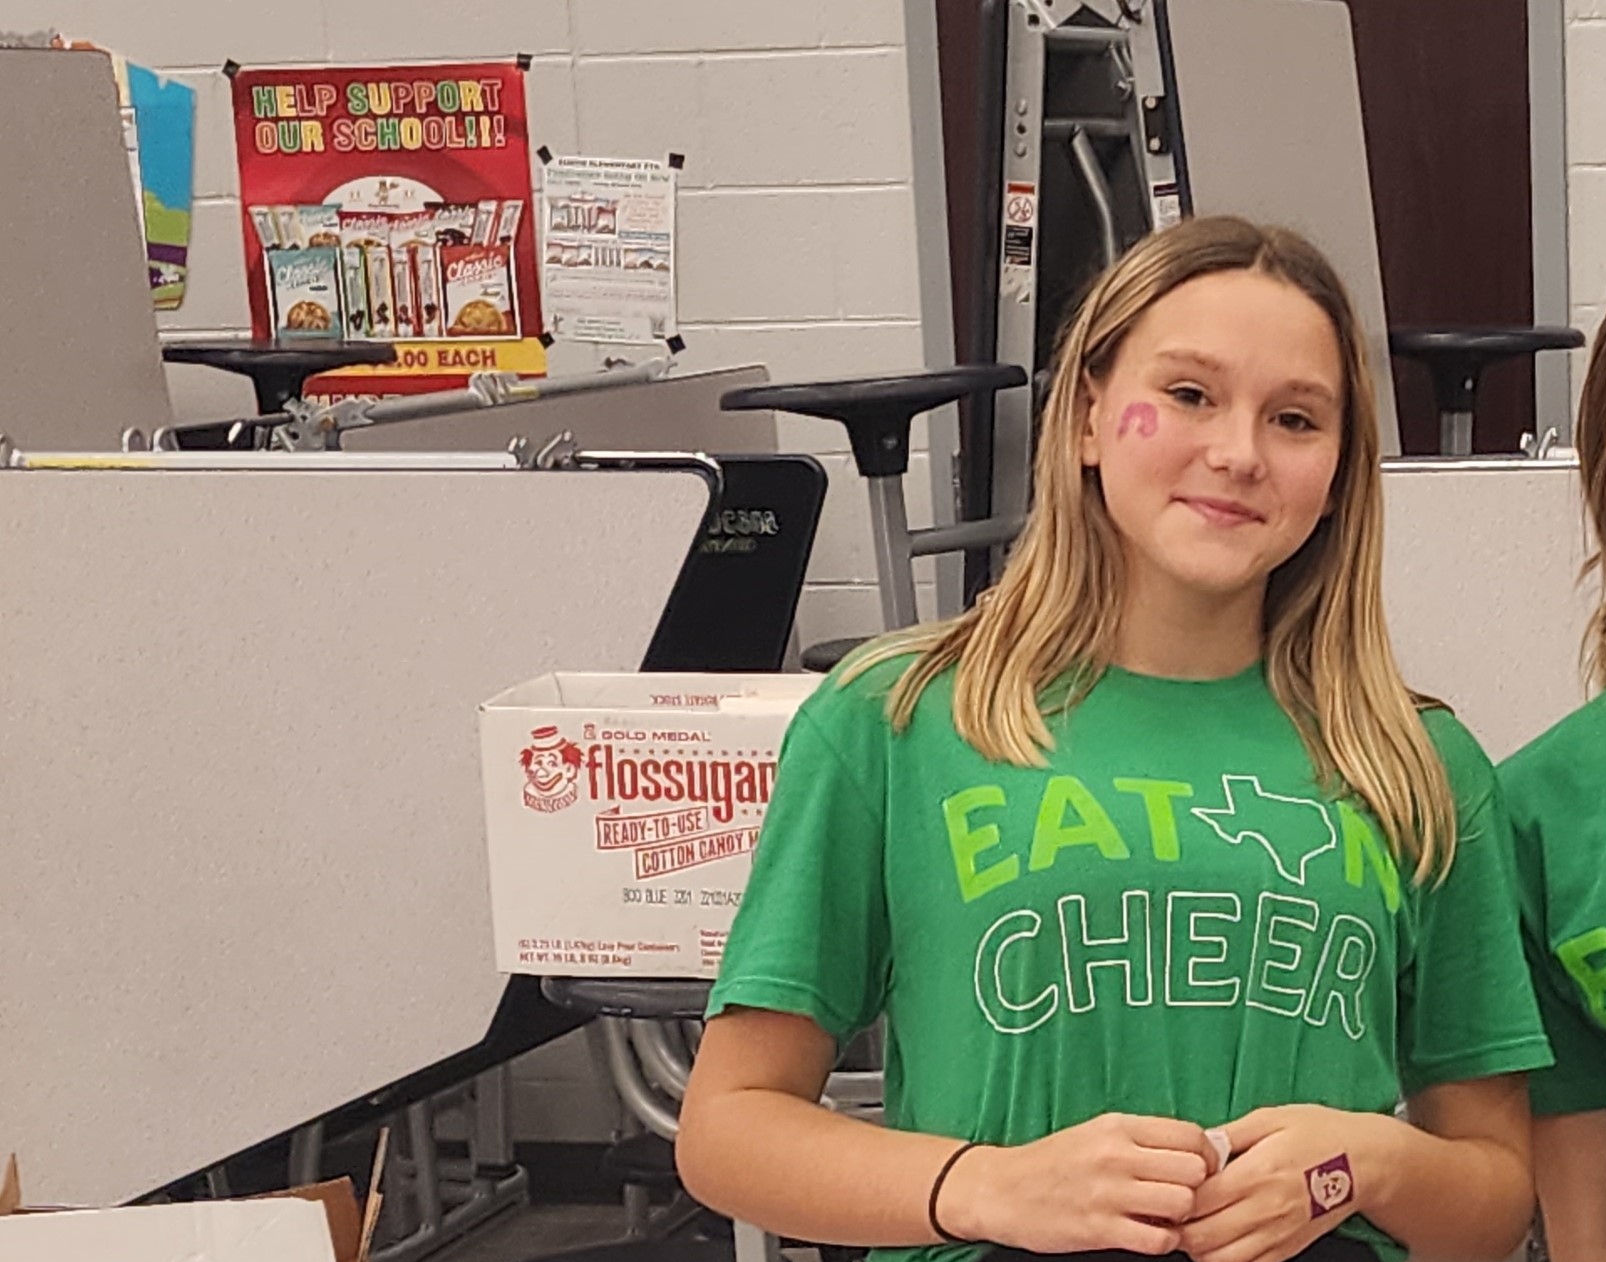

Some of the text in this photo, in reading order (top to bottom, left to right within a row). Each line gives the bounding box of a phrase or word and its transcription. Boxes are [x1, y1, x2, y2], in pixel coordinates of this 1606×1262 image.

[252, 79, 502, 118] HELP SUPPORT
[255, 115, 506, 153] OUR SCHOOL!!!
[448, 251, 503, 281] Classic
[394, 349, 497, 368] .00 EACH
[602, 731, 711, 742] GOLD MEDAL
[586, 744, 777, 823] flossugar
[603, 811, 704, 846] READY-TO-USE
[942, 774, 1400, 913] EATN
[642, 847, 695, 874] COTTON
[699, 832, 744, 858] CANDY
[973, 889, 1377, 1040] CHEER
